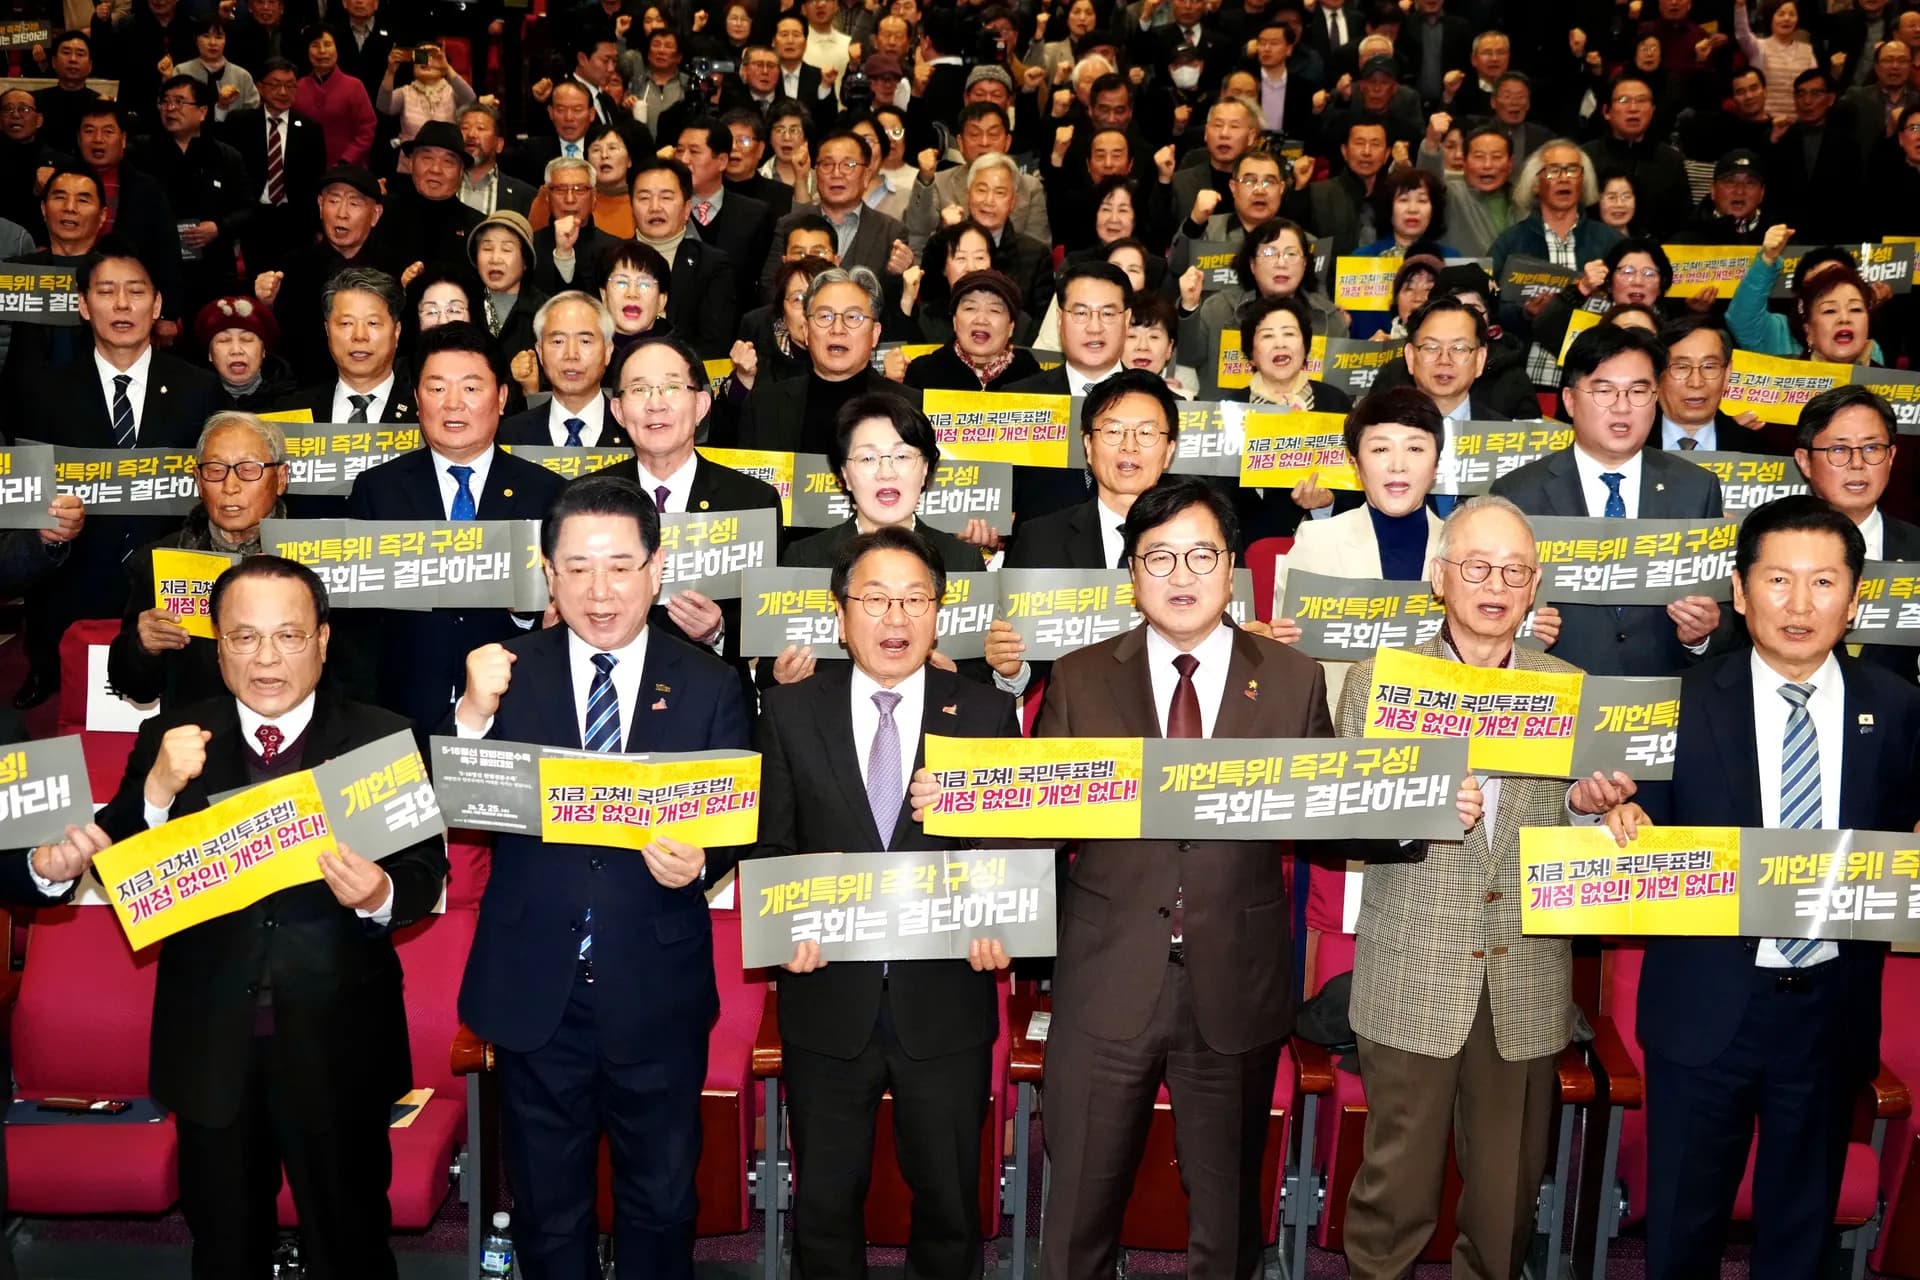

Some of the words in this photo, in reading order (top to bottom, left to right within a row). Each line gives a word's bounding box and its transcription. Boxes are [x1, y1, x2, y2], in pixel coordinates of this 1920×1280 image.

[39, 275, 73, 291] 즉각
[1728, 372, 1741, 384] 금
[1773, 376, 1834, 389] 국민투표법!
[1781, 390, 1810, 404] 개헌
[986, 410, 1052, 425] 국민투표법!
[284, 436, 327, 457] 특위!
[331, 432, 372, 455] 즉각
[375, 429, 420, 452] 구성!
[961, 427, 995, 443] 없인!
[998, 426, 1029, 441] 개헌
[1031, 425, 1067, 441] 없다!
[1248, 438, 1271, 452] 지금
[1485, 431, 1526, 453] 즉각
[1528, 429, 1576, 451] 구성!
[117, 457, 159, 479] 즉각
[541, 454, 582, 476] 즉각
[1246, 454, 1276, 470] 개정
[1279, 451, 1312, 467] 없인!
[1314, 449, 1345, 465] 개헌
[1736, 461, 1785, 483] 구성!
[935, 465, 980, 488] 구성!
[827, 495, 852, 519] 국
[379, 531, 426, 557] 즉각
[430, 527, 484, 554] 구성!
[658, 525, 681, 550] 각
[685, 516, 739, 548] 구성!
[1633, 532, 1683, 558] 즉각
[1685, 524, 1738, 553] 구성!
[393, 551, 512, 591] 결단하라!
[1554, 563, 1639, 592] 국회는
[160, 580, 188, 595] 지금
[1006, 585, 1109, 619] 개헌특위!
[1114, 583, 1137, 607] 즉
[164, 596, 196, 616] 개정
[1295, 595, 1401, 620] 개헌특위!
[1035, 614, 1121, 649] 국회는
[1322, 620, 1409, 649] 국회는
[1375, 683, 1412, 707] 지금
[1413, 689, 1458, 711] 고쳐!
[1460, 693, 1556, 714] 국민투표법!
[1373, 705, 1417, 731] 개정
[1421, 712, 1472, 738] 없인!
[1474, 714, 1519, 738] 개헌
[1524, 714, 1574, 738] 없다!
[1593, 699, 1681, 734] 개헌특
[340, 750, 429, 818] 개헌특
[971, 767, 1013, 787] 고쳐!
[1018, 760, 1115, 783] 국민투표법!
[1159, 757, 1284, 794] 개헌특위!
[1289, 751, 1349, 781] 즉각
[1352, 745, 1421, 778] 구성!
[548, 786, 586, 803] 지금
[590, 786, 633, 803] 고쳐!
[637, 777, 734, 806] 국민투표법!
[932, 790, 977, 815] 개정
[981, 787, 1032, 811] 없인!
[1036, 784, 1081, 807] 개헌
[1086, 779, 1139, 803] 없다!
[1194, 789, 1297, 826] 국회는
[1304, 774, 1452, 819] 결단하라!
[551, 804, 596, 823] 개정
[602, 803, 651, 827] 없인!
[655, 799, 701, 825] 개헌
[705, 791, 757, 816] 없다!
[115, 869, 155, 905] 지금
[156, 847, 200, 884] 고쳐!
[202, 799, 299, 859] 국민투표법!
[127, 891, 175, 926] 개정
[176, 862, 229, 900] 없인!
[230, 838, 275, 876] 개헌
[276, 812, 329, 850] 없다!
[1526, 862, 1564, 884] 지금
[1567, 858, 1611, 880] 고쳐!
[1615, 850, 1713, 876] 국민투표법!
[1757, 850, 1885, 887] 개헌특위!
[1891, 850, 1920, 879] 즉
[759, 872, 875, 918] 개헌특위!
[879, 864, 937, 896] 즉각
[942, 857, 1008, 892] 구성!
[1529, 884, 1574, 910] 개정
[1580, 879, 1631, 906] 없인!
[1635, 874, 1681, 901] 개헌
[1685, 871, 1737, 896] 없다!
[790, 906, 889, 945] 국회는
[897, 887, 1041, 937] 결단하라!
